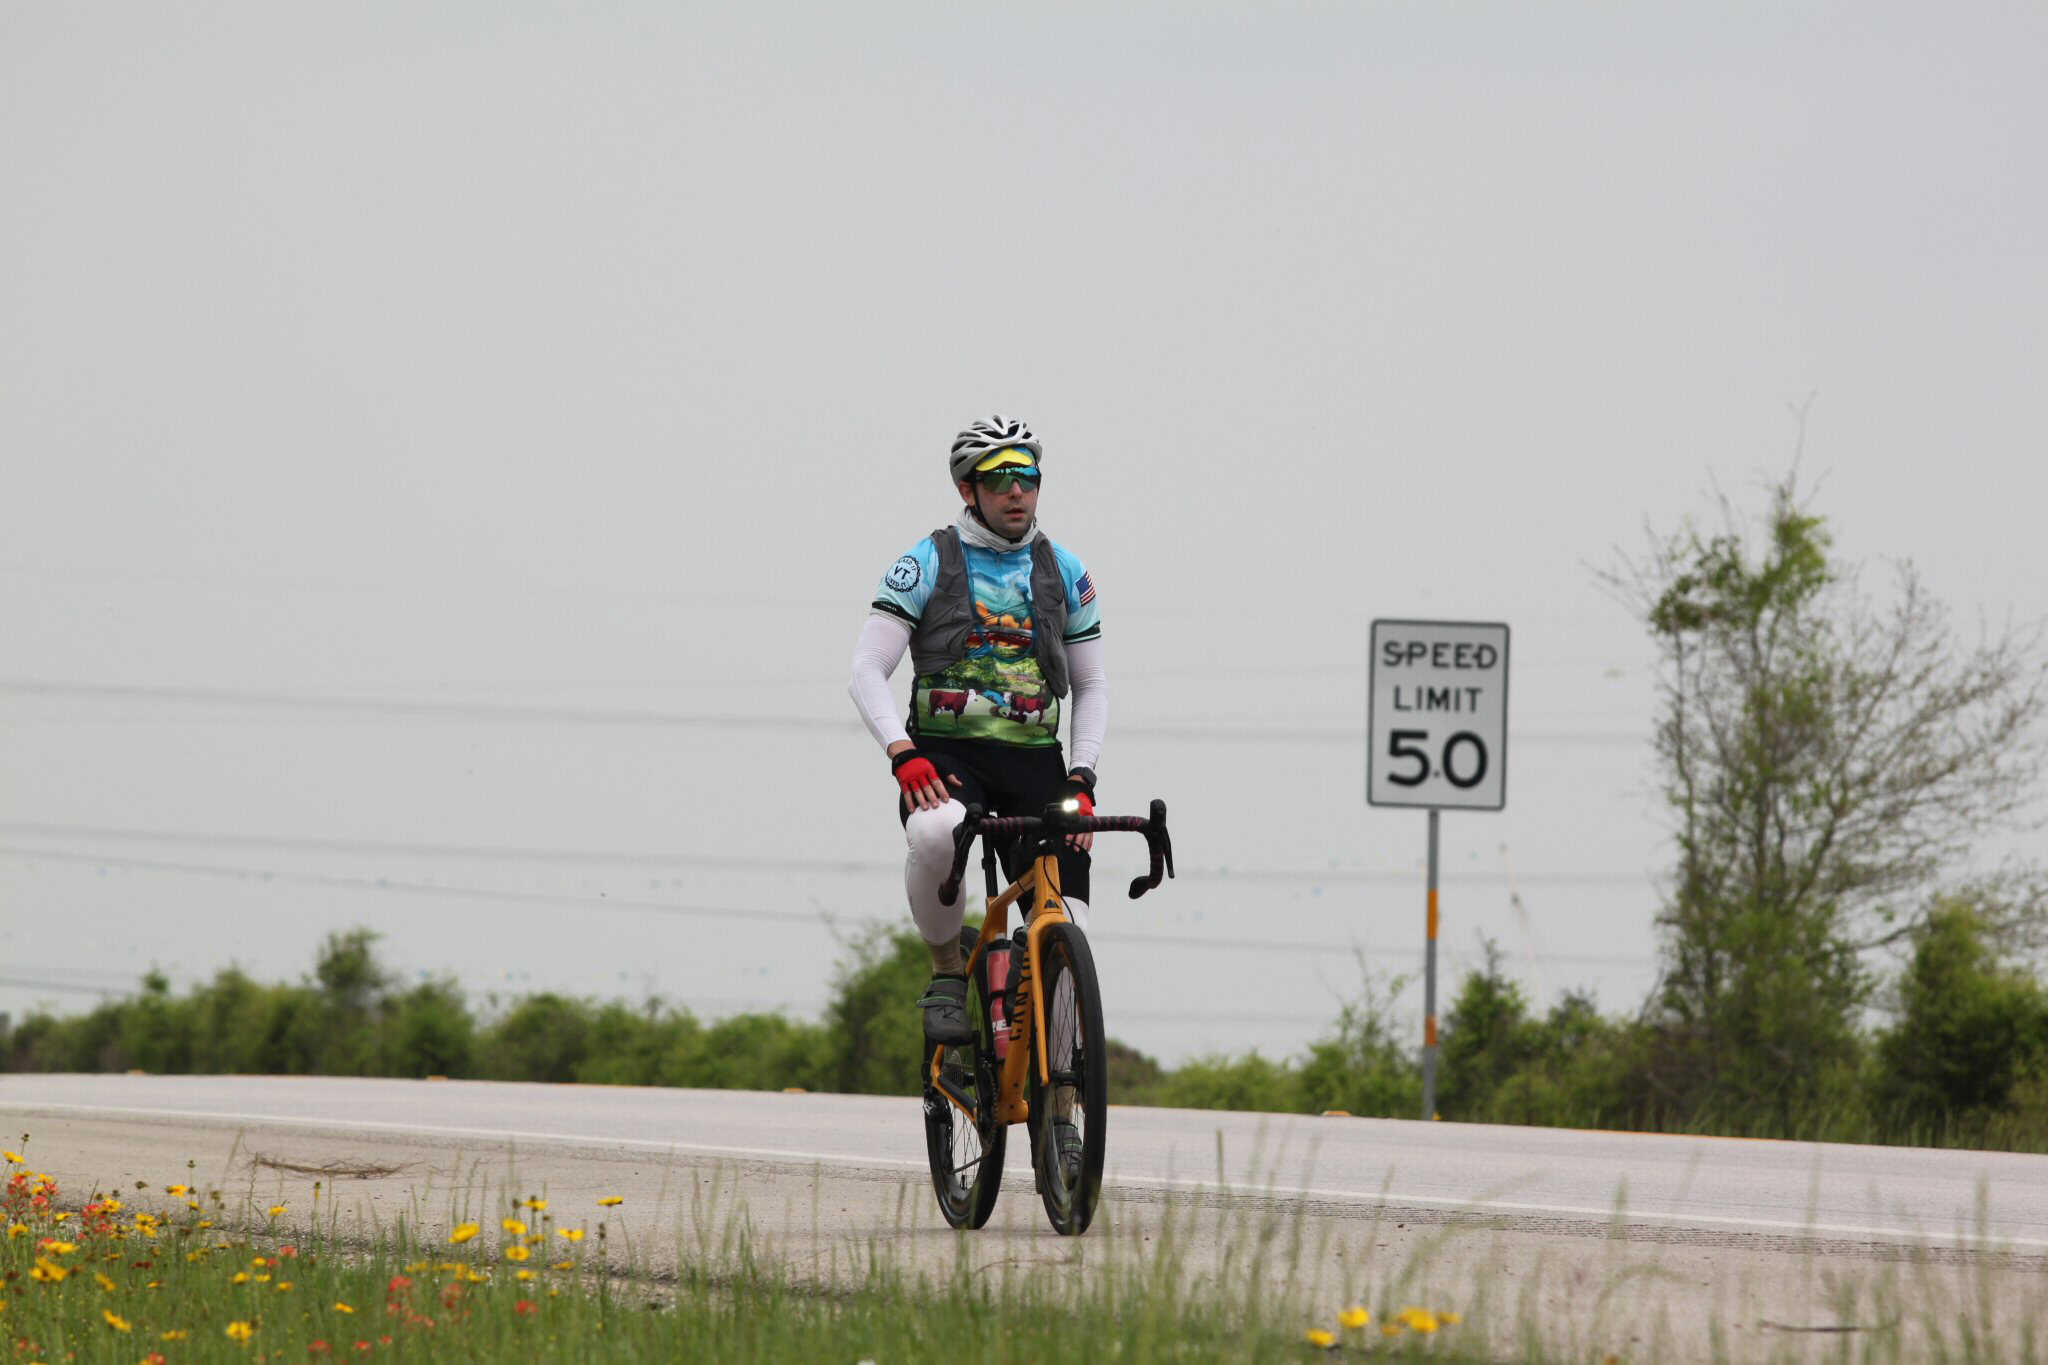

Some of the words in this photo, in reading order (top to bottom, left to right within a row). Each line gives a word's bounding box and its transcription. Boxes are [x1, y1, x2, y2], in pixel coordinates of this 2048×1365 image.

[893, 565, 910, 580] VT
[1383, 641, 1498, 670] SPEED
[1393, 684, 1483, 713] LIMIT
[1387, 728, 1489, 790] 50
